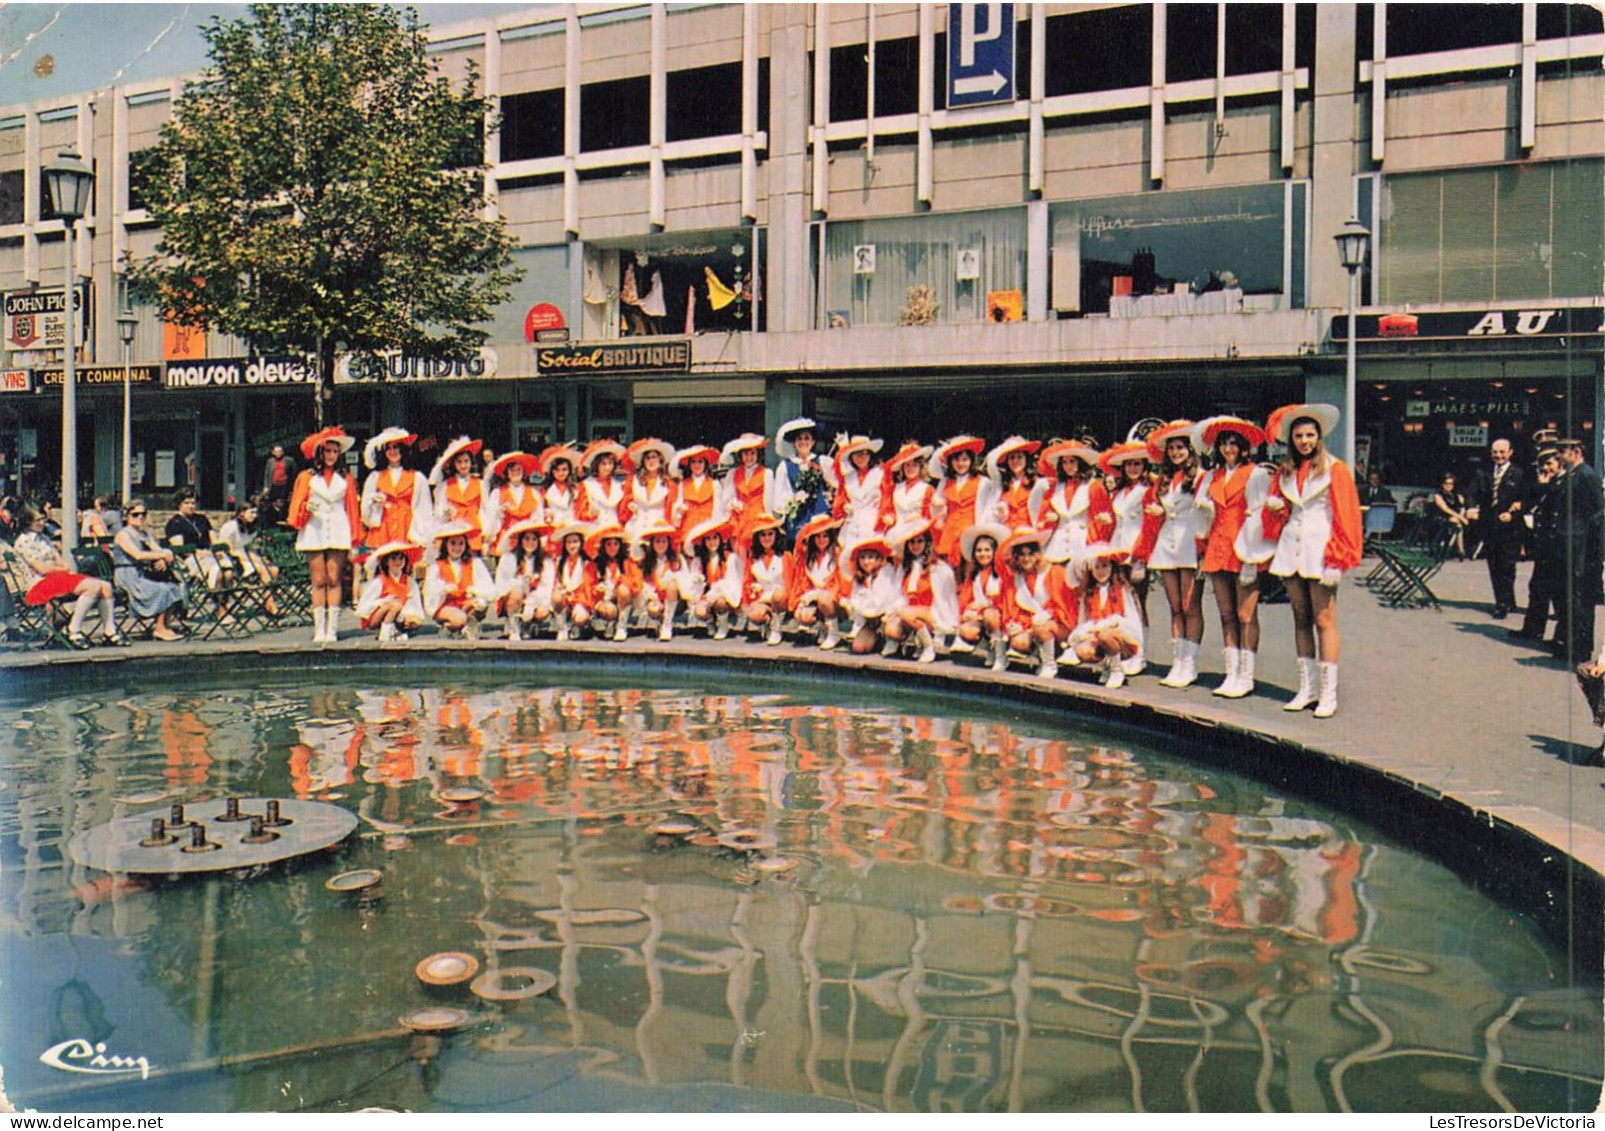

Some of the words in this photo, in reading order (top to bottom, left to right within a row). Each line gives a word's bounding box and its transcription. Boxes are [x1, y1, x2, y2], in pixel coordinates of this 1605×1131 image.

[960, 3, 1002, 67] P
[7, 296, 44, 313] JOHN
[46, 293, 79, 311] PIC
[1467, 310, 1555, 335] AU
[538, 348, 603, 369] Social
[603, 345, 686, 367] BOUTIQUE
[2, 371, 27, 389] VINS
[43, 371, 83, 385] CRET
[168, 364, 240, 386] maison
